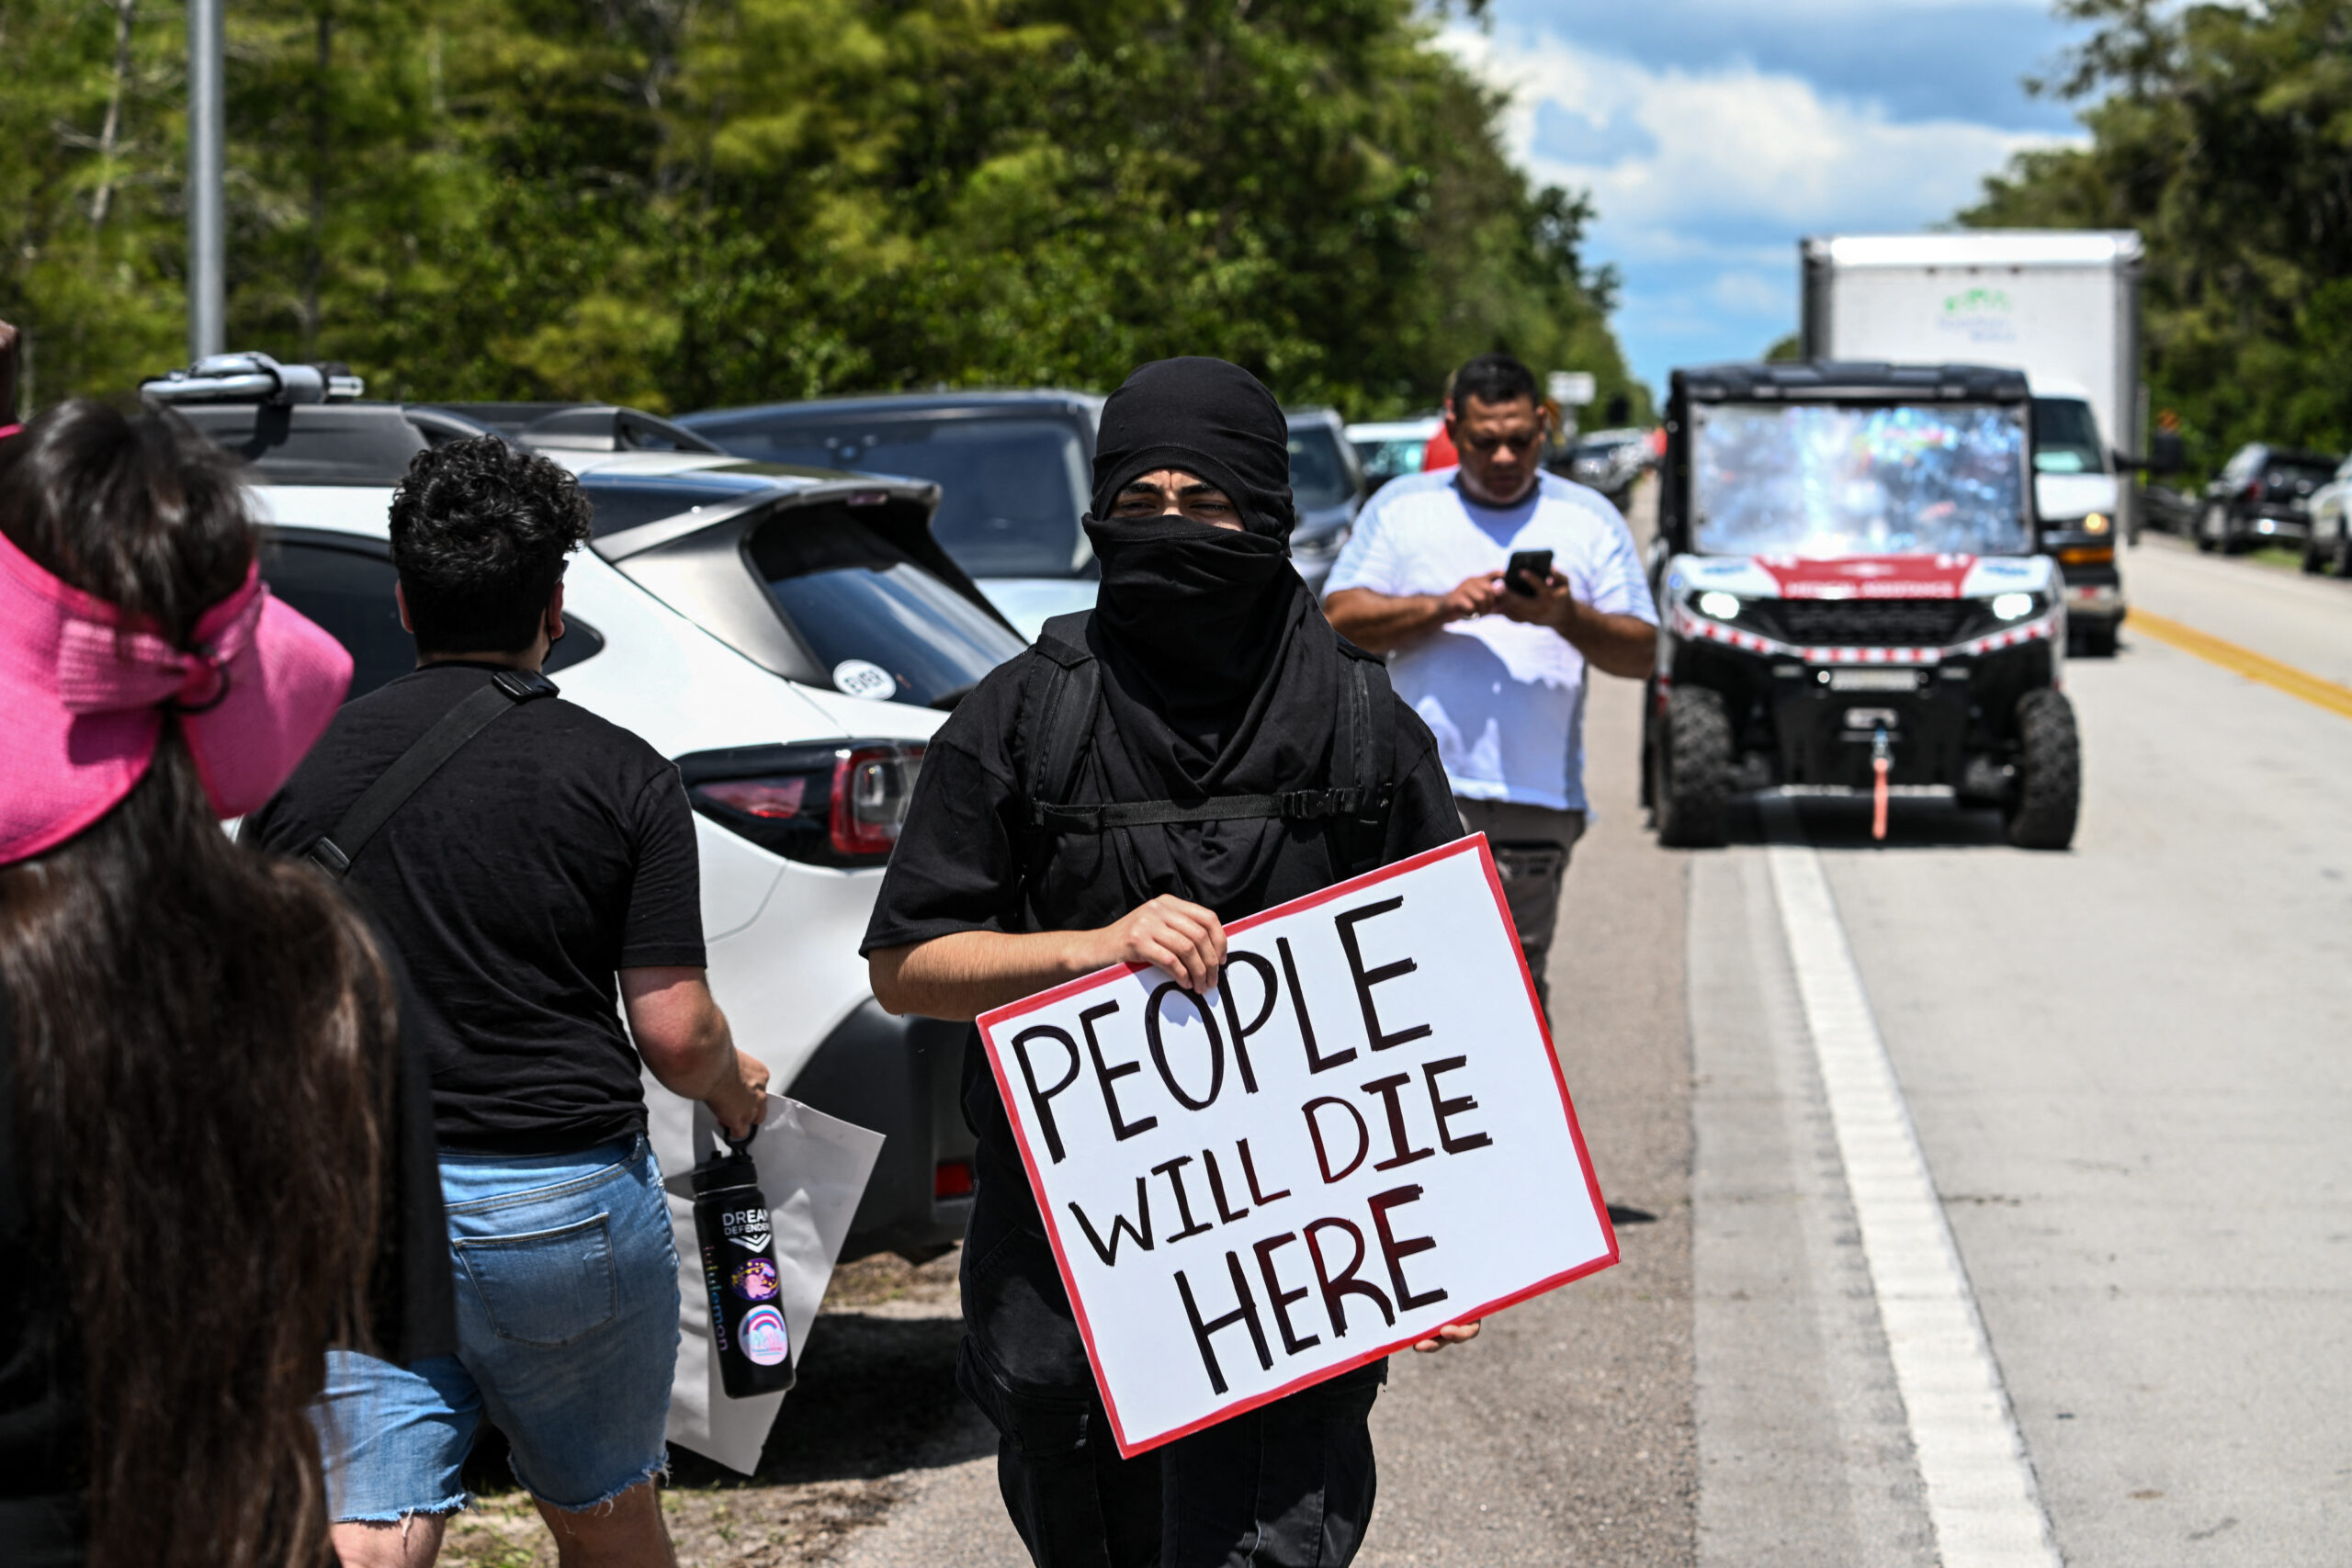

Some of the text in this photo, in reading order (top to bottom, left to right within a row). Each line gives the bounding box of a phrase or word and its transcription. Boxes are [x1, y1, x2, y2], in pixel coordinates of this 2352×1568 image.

[1012, 895, 1433, 1165] PEOPLE
[1068, 1055, 1493, 1267] WILL DIE
[702, 1246, 729, 1351] lululemon
[1174, 1183, 1449, 1395] HERE
